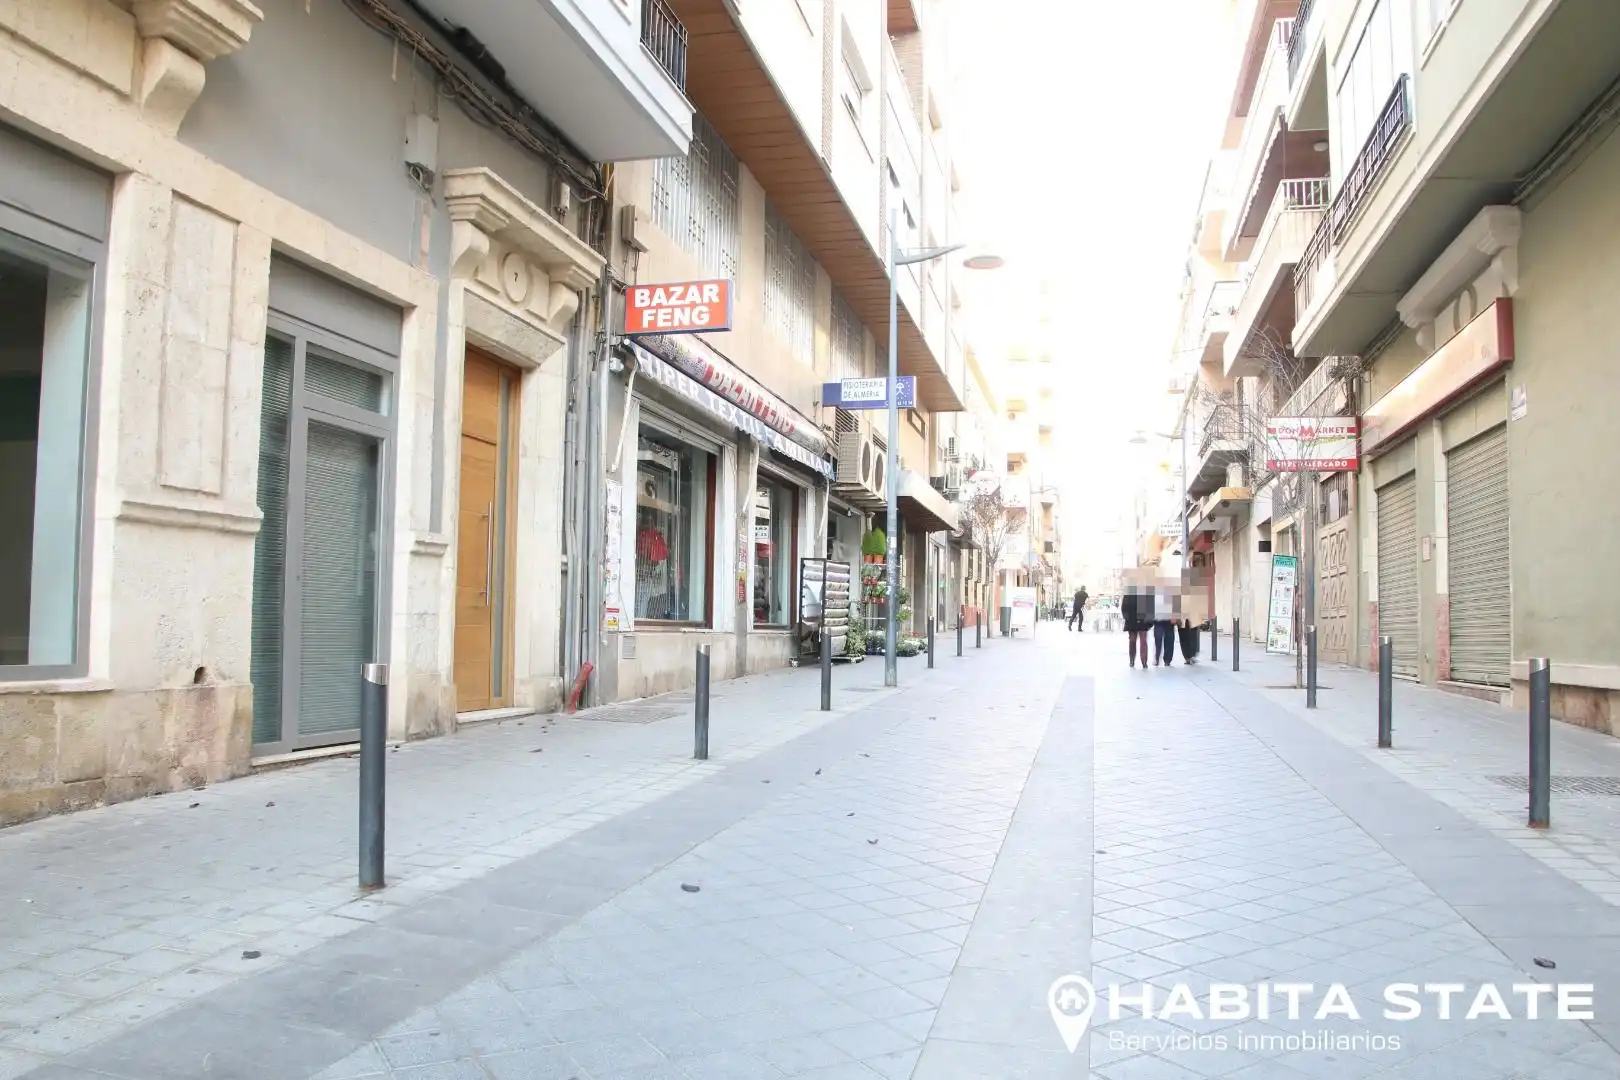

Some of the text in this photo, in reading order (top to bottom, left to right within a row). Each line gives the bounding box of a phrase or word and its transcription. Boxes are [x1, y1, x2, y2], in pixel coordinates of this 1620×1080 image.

[513, 271, 519, 282] 7
[634, 284, 719, 308] BAZAR
[642, 305, 710, 328] FENG
[843, 391, 852, 399] DE
